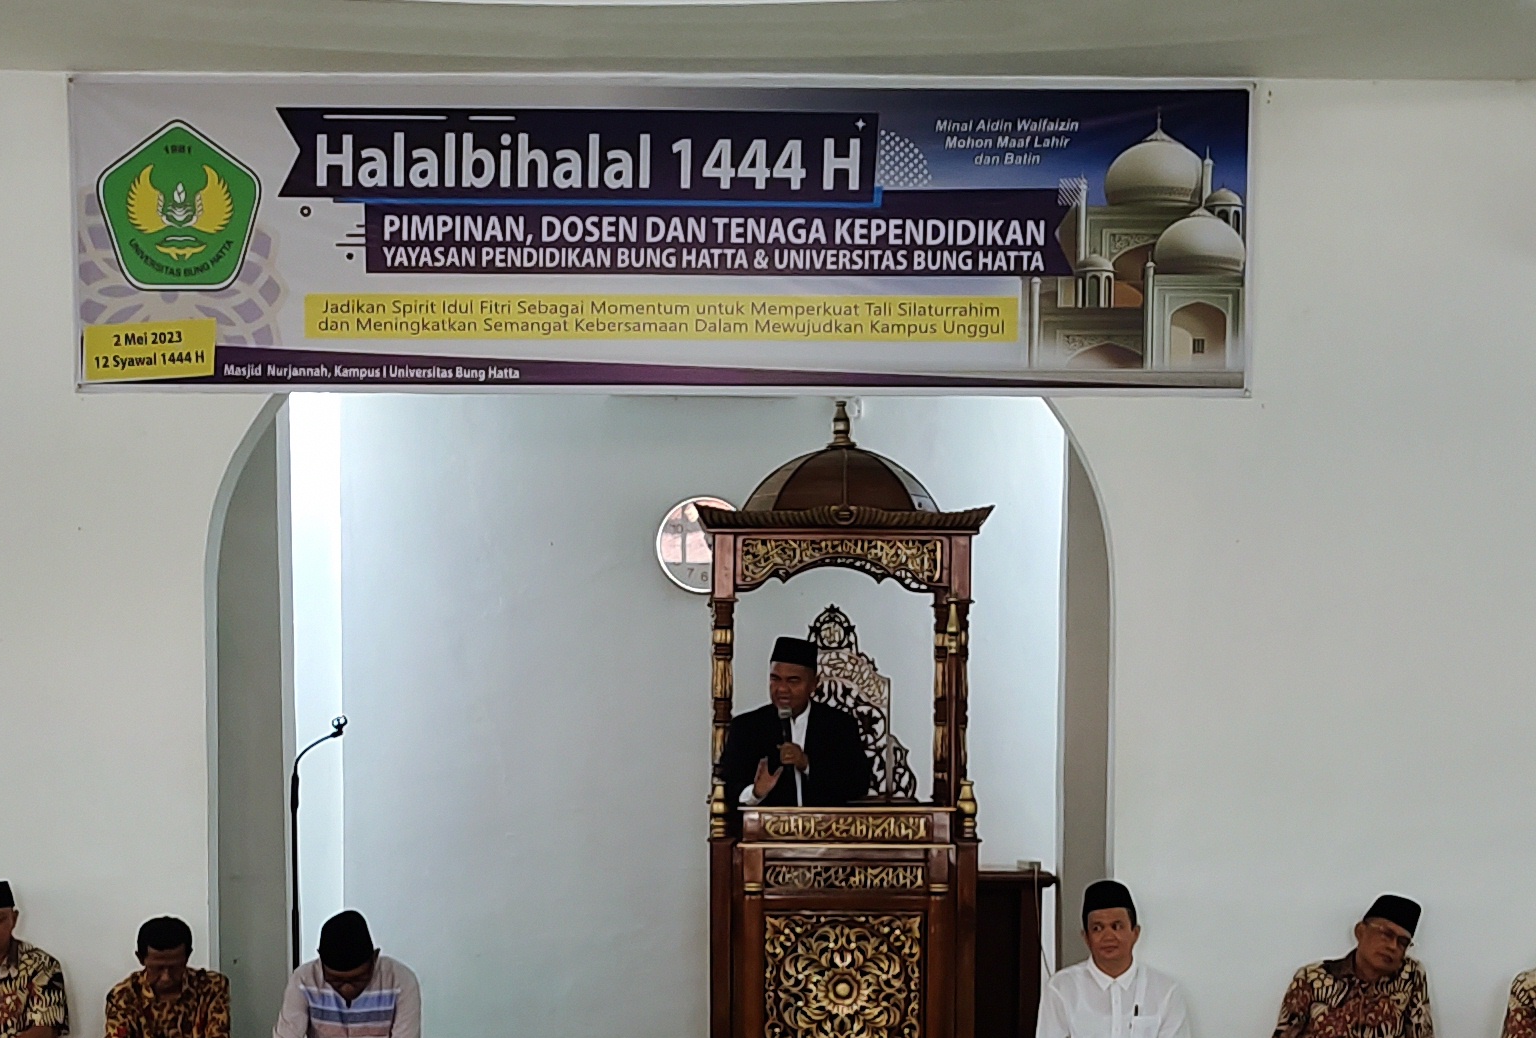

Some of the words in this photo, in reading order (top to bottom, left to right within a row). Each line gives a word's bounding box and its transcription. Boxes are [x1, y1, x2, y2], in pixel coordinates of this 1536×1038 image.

[935, 119, 973, 132] Minal
[975, 119, 1013, 132] Aidin
[945, 136, 992, 149] Mohon
[996, 136, 1030, 149] Maaf
[1034, 136, 1070, 149] Lahir
[316, 132, 651, 189] Halalbihalal
[671, 138, 806, 190] 1444
[823, 137, 861, 191] H
[974, 153, 1000, 166] dan
[1003, 152, 1040, 166] Batin
[383, 214, 534, 246] PIMPINAN,
[541, 215, 638, 243] DOSEN
[645, 216, 707, 243] DAN
[711, 217, 827, 245] TENAGA
[834, 218, 1046, 246] KEPENDIDIKAN
[129, 238, 181, 277] UNIVERSITAS
[209, 239, 234, 268] HATTA
[382, 246, 476, 267] YAYASAN
[481, 247, 611, 268] PENDIDIKAN
[617, 248, 676, 268] BUNG
[681, 248, 749, 269] HATTA
[753, 249, 769, 269] &
[774, 249, 908, 271] UNIVERSITAS
[913, 251, 973, 271] BUNG
[978, 251, 1045, 271] HATTA
[323, 300, 386, 314] Jadikan
[392, 300, 436, 317] Spirit
[442, 301, 473, 314] Idul
[480, 301, 511, 315] Fitri
[517, 300, 584, 317] Sebagai
[590, 301, 690, 315] Momentum
[696, 301, 744, 316] untuk
[751, 302, 860, 318] Memperkuat
[865, 302, 892, 317] Tali
[898, 302, 1000, 317] Silaturrahim
[318, 317, 350, 331] dan
[356, 317, 477, 335] Meningkatkan
[483, 317, 568, 335] Semangat
[574, 318, 689, 333] Kebersamaan
[695, 318, 749, 333] Dalam
[755, 319, 863, 336] Mewujudkan
[870, 319, 937, 337] Kampus
[943, 320, 1005, 338] Unggul
[113, 334, 121, 346] 2
[124, 332, 147, 346] Mei
[151, 330, 182, 345] 2023
[94, 355, 109, 369] 12
[112, 352, 156, 370] Syawal
[160, 351, 191, 366] 1444
[195, 350, 204, 363] H
[223, 364, 262, 379] Masjid
[267, 364, 331, 380] Nurjannah,
[334, 365, 381, 379] Kampus
[389, 365, 453, 378] Universitas
[455, 366, 486, 381] Bung
[488, 366, 520, 379] Hatta
[687, 567, 695, 577] 7
[701, 571, 709, 582] 6
